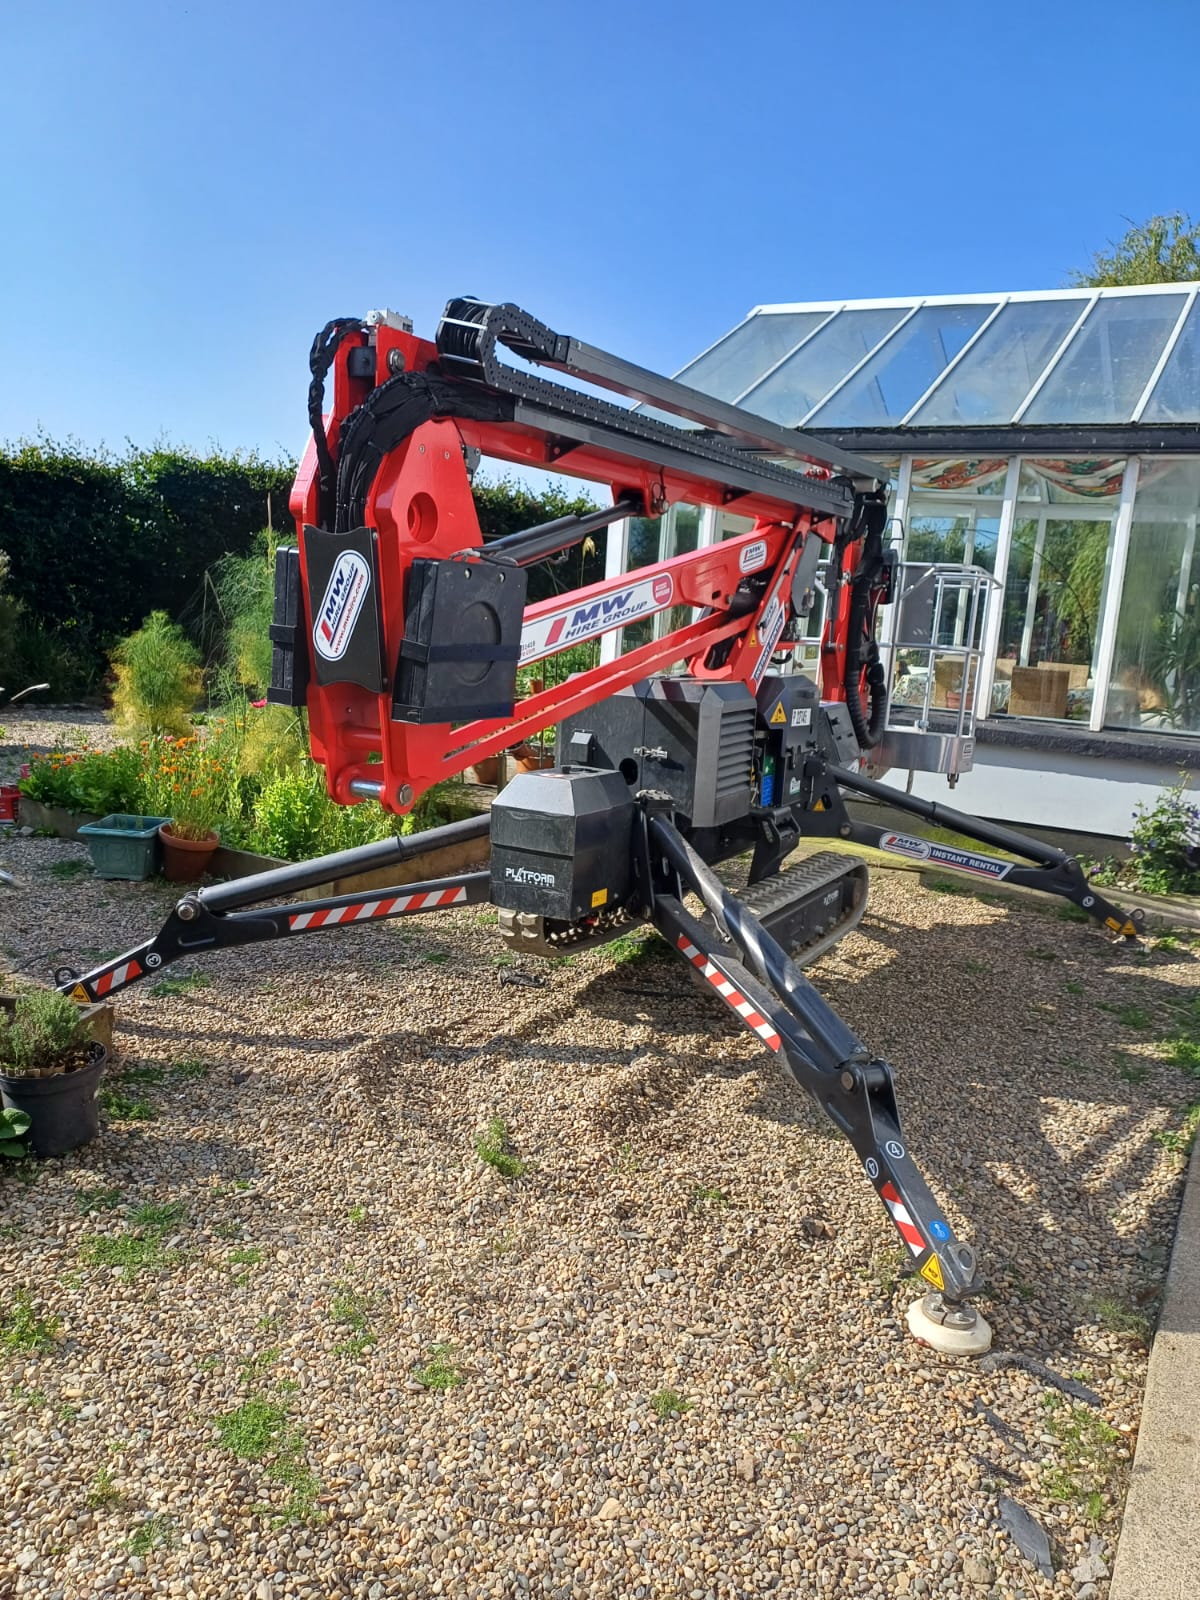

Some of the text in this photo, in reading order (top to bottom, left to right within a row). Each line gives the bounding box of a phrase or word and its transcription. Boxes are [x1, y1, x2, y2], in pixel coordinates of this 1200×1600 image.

[325, 567, 345, 622] MW
[331, 563, 355, 629] HIRE GROUP
[571, 590, 634, 627] MW
[565, 600, 648, 639] HIRE GROUP
[897, 838, 922, 847] MW
[932, 849, 967, 864] INSTANT
[969, 859, 1001, 873] RENTAL
[505, 866, 555, 884] PLATFORM
